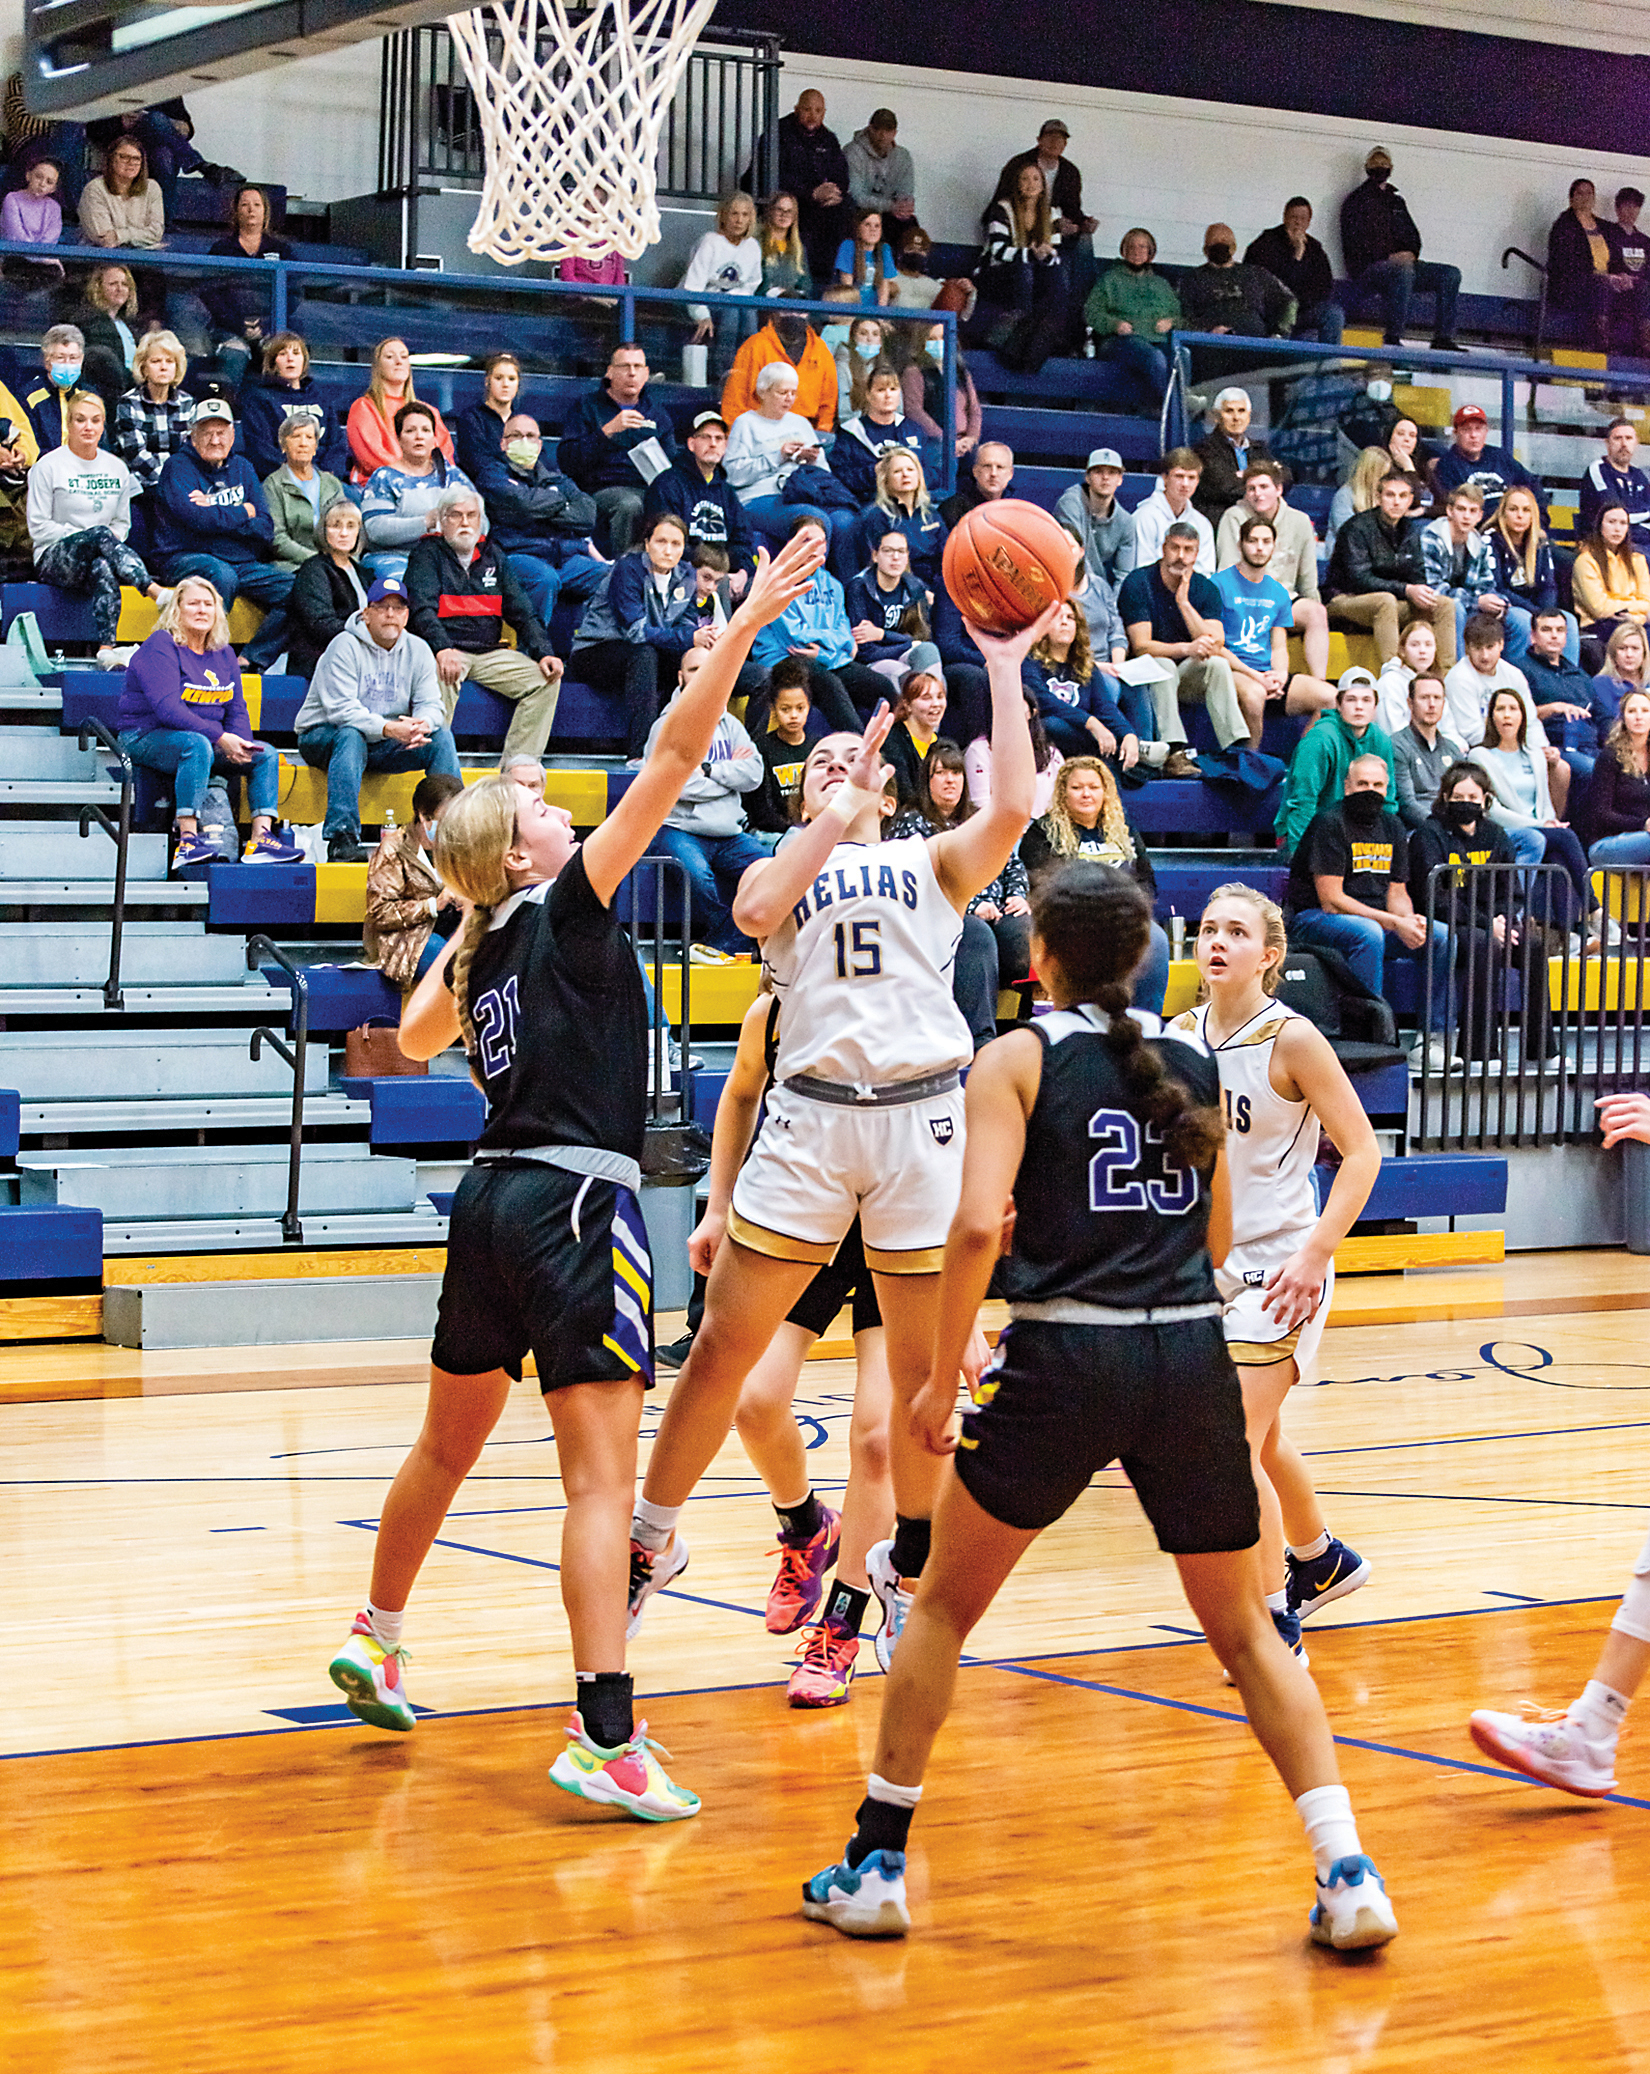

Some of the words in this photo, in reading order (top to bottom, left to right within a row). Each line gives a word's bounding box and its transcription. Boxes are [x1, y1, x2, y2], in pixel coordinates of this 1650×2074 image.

[86, 478, 121, 490] JOSEPH
[833, 919, 883, 980] 15
[473, 974, 521, 1080] 21
[932, 1120, 952, 1138] HC
[1088, 1108, 1199, 1216] 23
